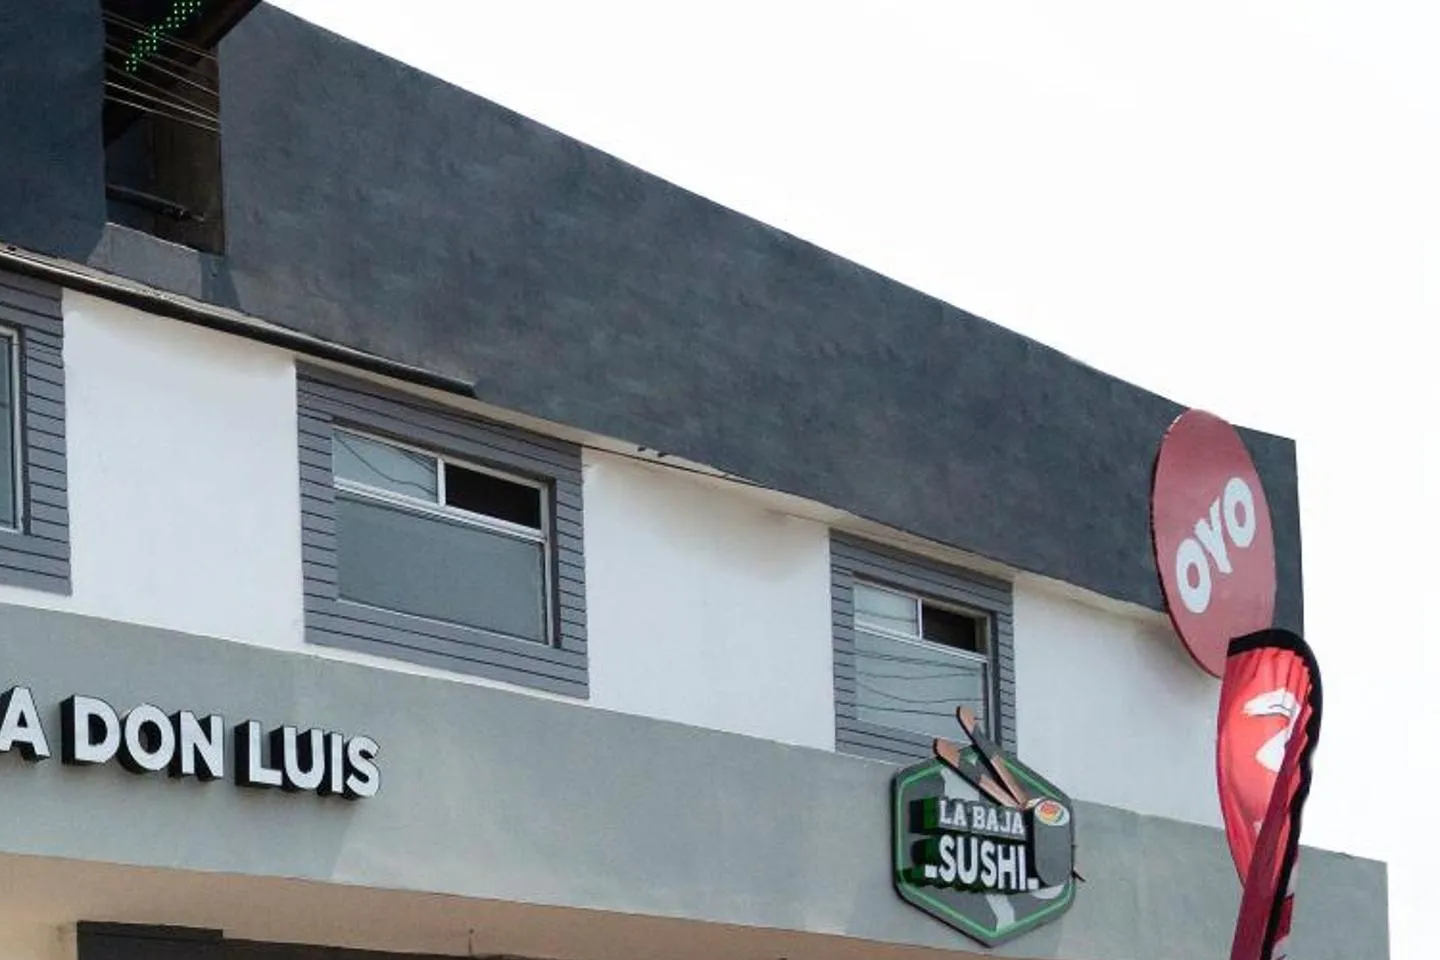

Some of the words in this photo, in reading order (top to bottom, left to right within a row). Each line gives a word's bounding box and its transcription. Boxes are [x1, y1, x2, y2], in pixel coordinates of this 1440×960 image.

[1176, 477, 1256, 613] OYO
[62, 694, 224, 780] DON
[235, 719, 381, 800] LUIS
[939, 799, 968, 830] LA
[971, 804, 1025, 836] BAJA
